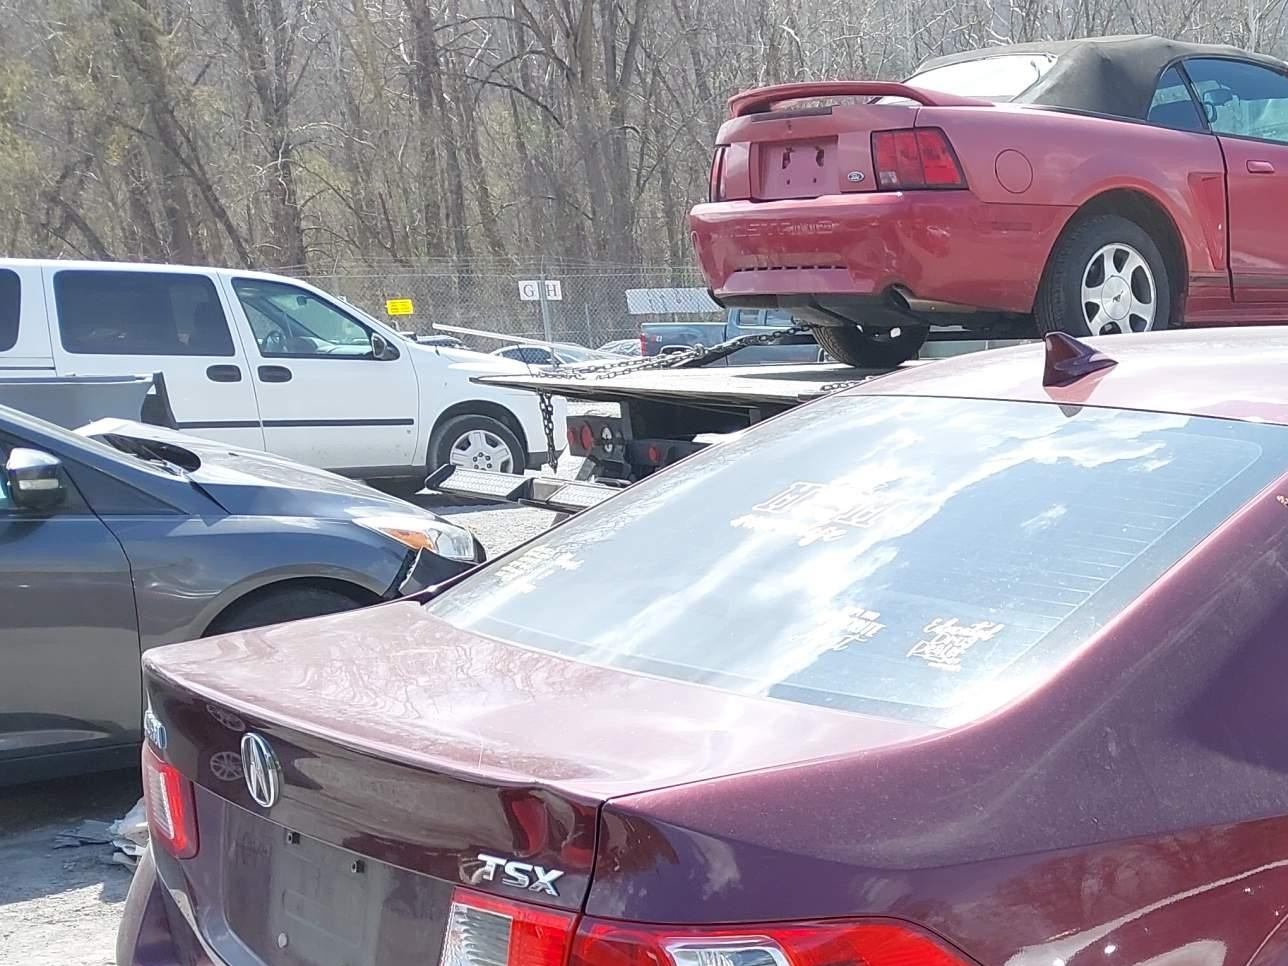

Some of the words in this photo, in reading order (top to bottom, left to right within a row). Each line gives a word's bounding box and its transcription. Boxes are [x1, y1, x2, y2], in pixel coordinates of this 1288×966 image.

[523, 284, 535, 298] G
[545, 284, 558, 297] H
[477, 853, 565, 897] TSX
